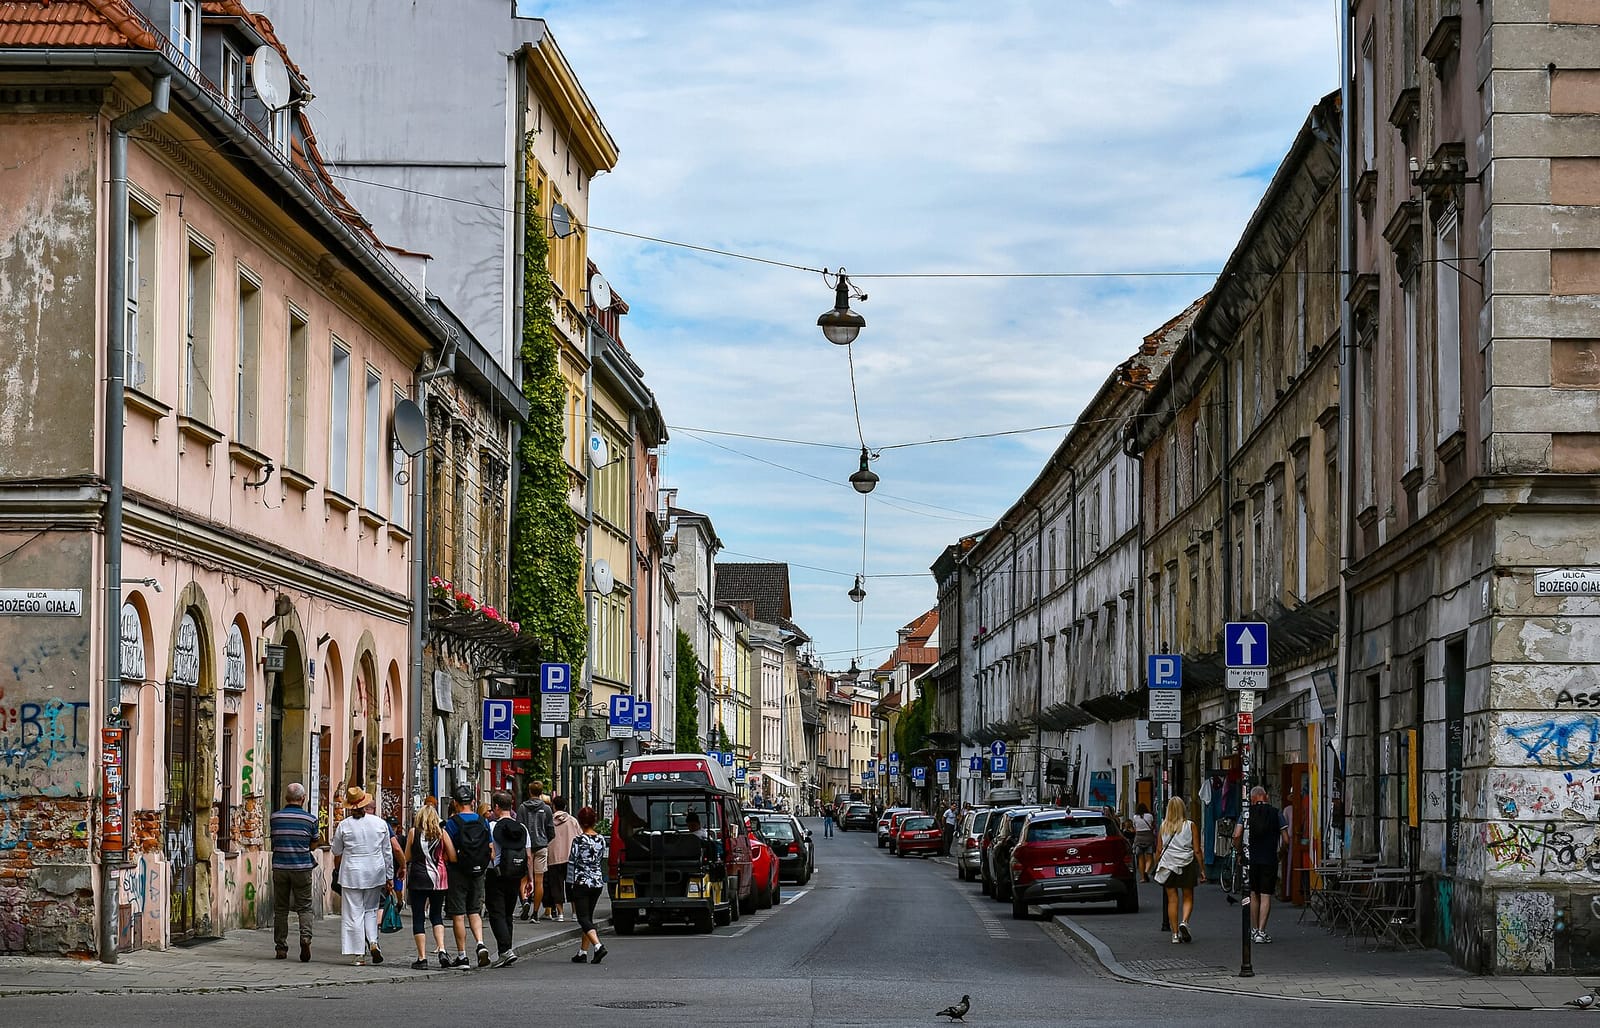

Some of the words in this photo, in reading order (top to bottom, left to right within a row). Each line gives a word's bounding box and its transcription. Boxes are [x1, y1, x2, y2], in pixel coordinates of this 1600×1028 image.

[1539, 578, 1579, 592] BOŻEGO
[45, 600, 76, 612] CIAŁA
[547, 666, 565, 690] P
[1155, 658, 1174, 685] P
[615, 697, 630, 717] P
[634, 704, 648, 722] P
[489, 703, 507, 730] P
[725, 754, 731, 764] P
[939, 760, 947, 771] P
[994, 758, 1003, 770] P
[916, 768, 923, 777] P
